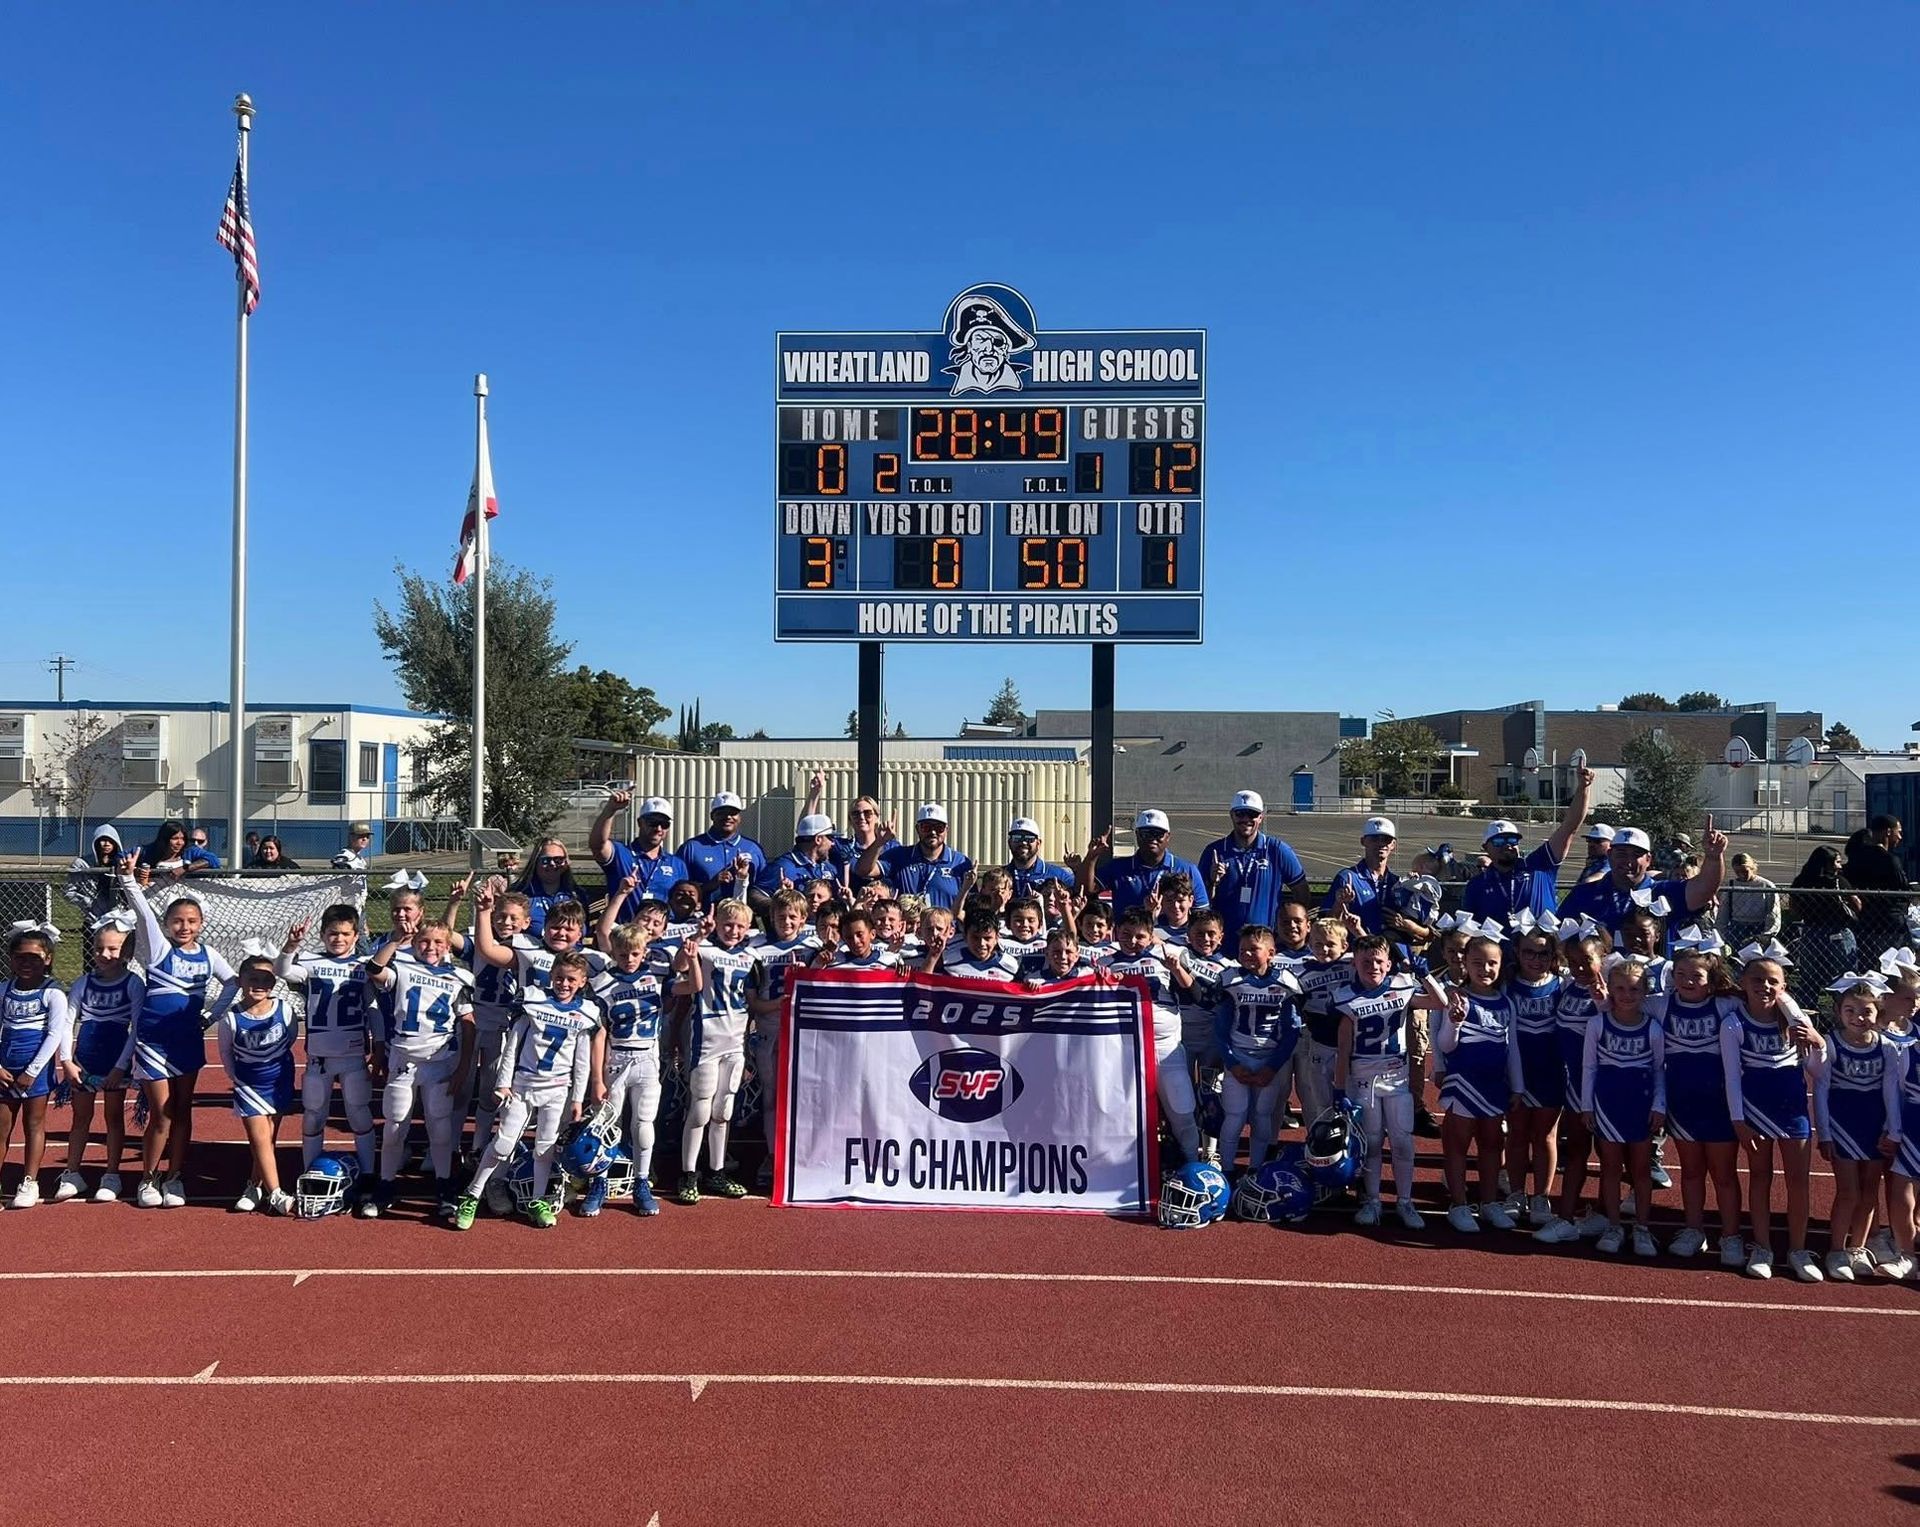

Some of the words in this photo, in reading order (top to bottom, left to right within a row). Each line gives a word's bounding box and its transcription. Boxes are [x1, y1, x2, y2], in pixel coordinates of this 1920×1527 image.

[783, 351, 931, 383] WHEATLAND
[1032, 350, 1093, 382] HIGH
[1099, 348, 1199, 382] SCHOOL
[801, 409, 879, 441] HOME
[916, 409, 1061, 459] 28:49
[1083, 407, 1195, 440] GUESTS
[817, 444, 845, 495] 0
[876, 454, 898, 493] 2
[1095, 455, 1101, 490] 1
[1153, 442, 1197, 494] 12
[785, 503, 851, 535] DOWN
[867, 503, 911, 536] YDS
[918, 503, 945, 535] TO
[951, 503, 982, 535] GO
[1010, 503, 1061, 535] BALL
[1068, 503, 1098, 535] ON
[1137, 502, 1183, 535] QTR
[806, 537, 831, 588] 3
[931, 537, 960, 589] 0
[1022, 537, 1085, 589] 50
[1167, 540, 1174, 585] 1
[858, 602, 927, 634] HOME
[933, 602, 963, 634] OF
[968, 603, 1013, 634] THE
[1018, 602, 1119, 635] PIRATES
[409, 972, 454, 993] WHEATLAND
[310, 978, 364, 1027] 72
[401, 985, 453, 1033] 14
[912, 999, 1023, 1027] 2025
[1351, 997, 1405, 1017] WHEATLAND
[536, 1010, 585, 1031] WHEATLAND
[1355, 1012, 1402, 1055] 21
[1671, 1015, 1718, 1038] WJP
[536, 1025, 569, 1072] 7
[1605, 1032, 1646, 1055] WJP
[1840, 1055, 1883, 1077] WJP
[844, 1137, 900, 1187] FVC
[909, 1138, 1088, 1195] CHAMPIONS
